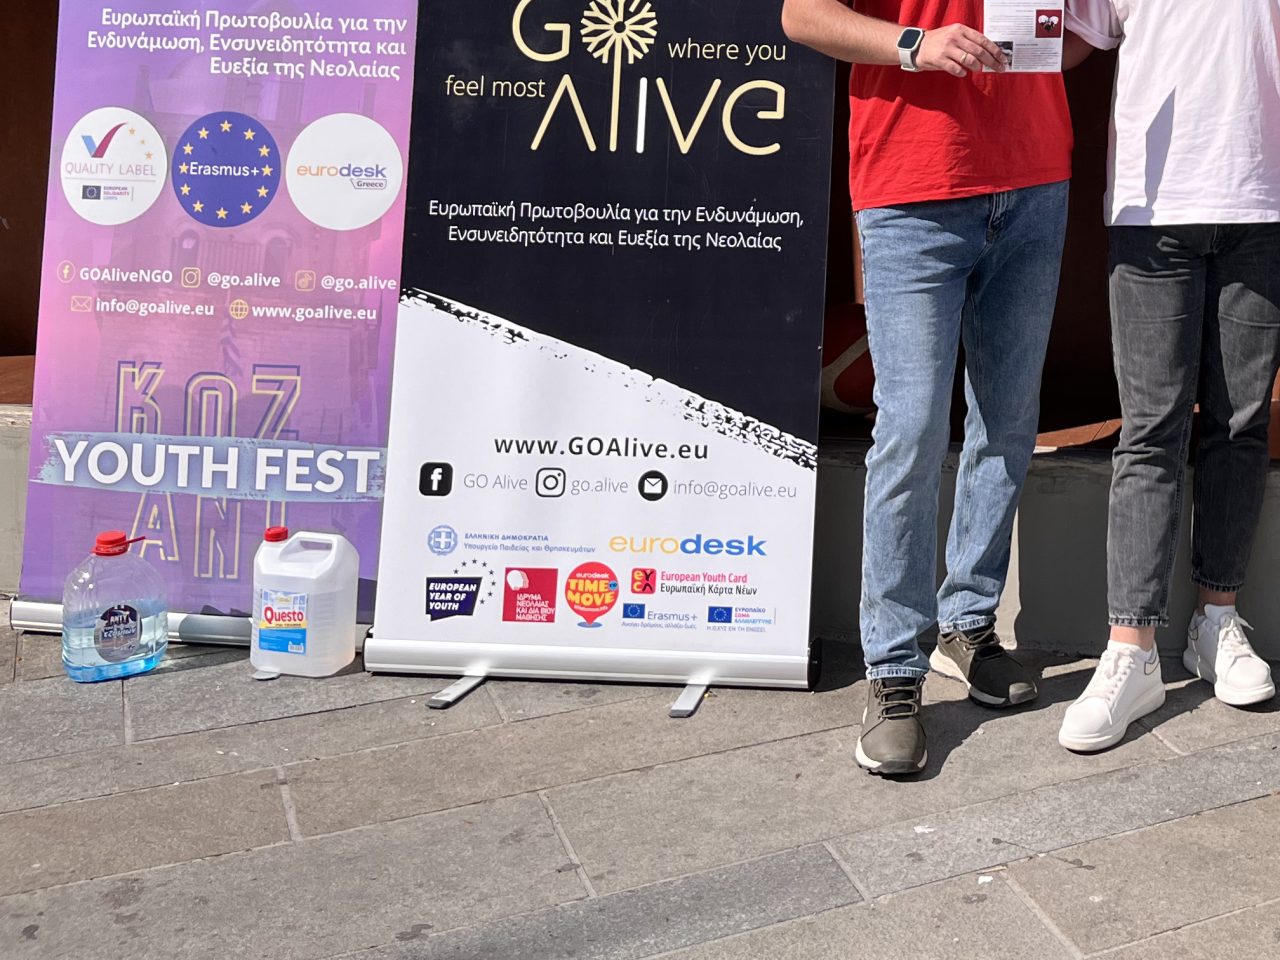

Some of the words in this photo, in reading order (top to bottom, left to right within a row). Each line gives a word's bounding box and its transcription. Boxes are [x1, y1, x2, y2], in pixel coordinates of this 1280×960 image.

[101, 8, 201, 30] Ευρωπαϊκή
[205, 10, 333, 32] Πρωτοβουλία
[338, 15, 369, 33] για
[373, 17, 407, 35] την
[87, 31, 205, 54] Ενδυνάμωση,
[209, 33, 371, 56] Ενσυνειδητότητα
[376, 38, 407, 55] και
[668, 38, 739, 60] where
[745, 42, 786, 65] you
[210, 57, 269, 77] Ευεξία
[273, 60, 305, 79] της
[310, 60, 400, 81] Νεολαίας
[445, 75, 484, 97] feel
[492, 76, 545, 98] most
[65, 162, 114, 176] QUALITY
[119, 164, 156, 176] LABEL
[189, 161, 259, 177] Erasmus+
[296, 163, 387, 178] eurodesk
[356, 180, 384, 189] Greece
[429, 200, 516, 218] Ευρωπαϊκή
[520, 201, 630, 223] Πρωτοβουλία
[634, 205, 659, 224] για
[662, 208, 691, 225] την
[696, 206, 804, 228] Ενδυνάμωση,
[448, 226, 584, 247] Ενσυνειδητότητα
[588, 230, 613, 245] και
[618, 230, 669, 249] Ευεξία
[673, 233, 701, 251] της
[706, 232, 782, 252] Νεολαίας
[79, 267, 173, 283] GOAliveNGO
[207, 273, 281, 288] @go.alive
[320, 275, 397, 291] @go.alive
[96, 298, 214, 317] info@goalive.eu
[251, 304, 377, 322] www.goalive.eu
[494, 437, 709, 460] www.GOAlive.eu
[54, 439, 239, 489] YOUTH
[255, 448, 380, 494] FEST
[463, 474, 489, 489] GO
[493, 475, 528, 490] Alive
[571, 477, 629, 497] go.alive
[673, 479, 797, 499] info@goalive.eu
[465, 532, 500, 540] ΕΛΛΗΝΙΚΗ
[501, 533, 549, 541] ΔΗΜΟΚΡΑΤΙΑ
[464, 543, 498, 552] Υπουργείο
[500, 543, 529, 552] Παιδείας
[609, 535, 767, 556] eurodesk
[661, 571, 700, 582] European
[702, 571, 726, 582] Youth
[728, 573, 747, 583] Card
[429, 583, 477, 591] EUROPEAN
[568, 579, 609, 592] TIME
[660, 583, 706, 595] Ευρωπαϊκή
[708, 584, 733, 596] Κάρτα
[735, 585, 757, 595] Νέων
[429, 592, 452, 601] YEAR
[454, 593, 466, 601] OF
[567, 590, 615, 606] MOVE
[429, 602, 459, 610] YOUTH
[264, 606, 304, 624] Questo
